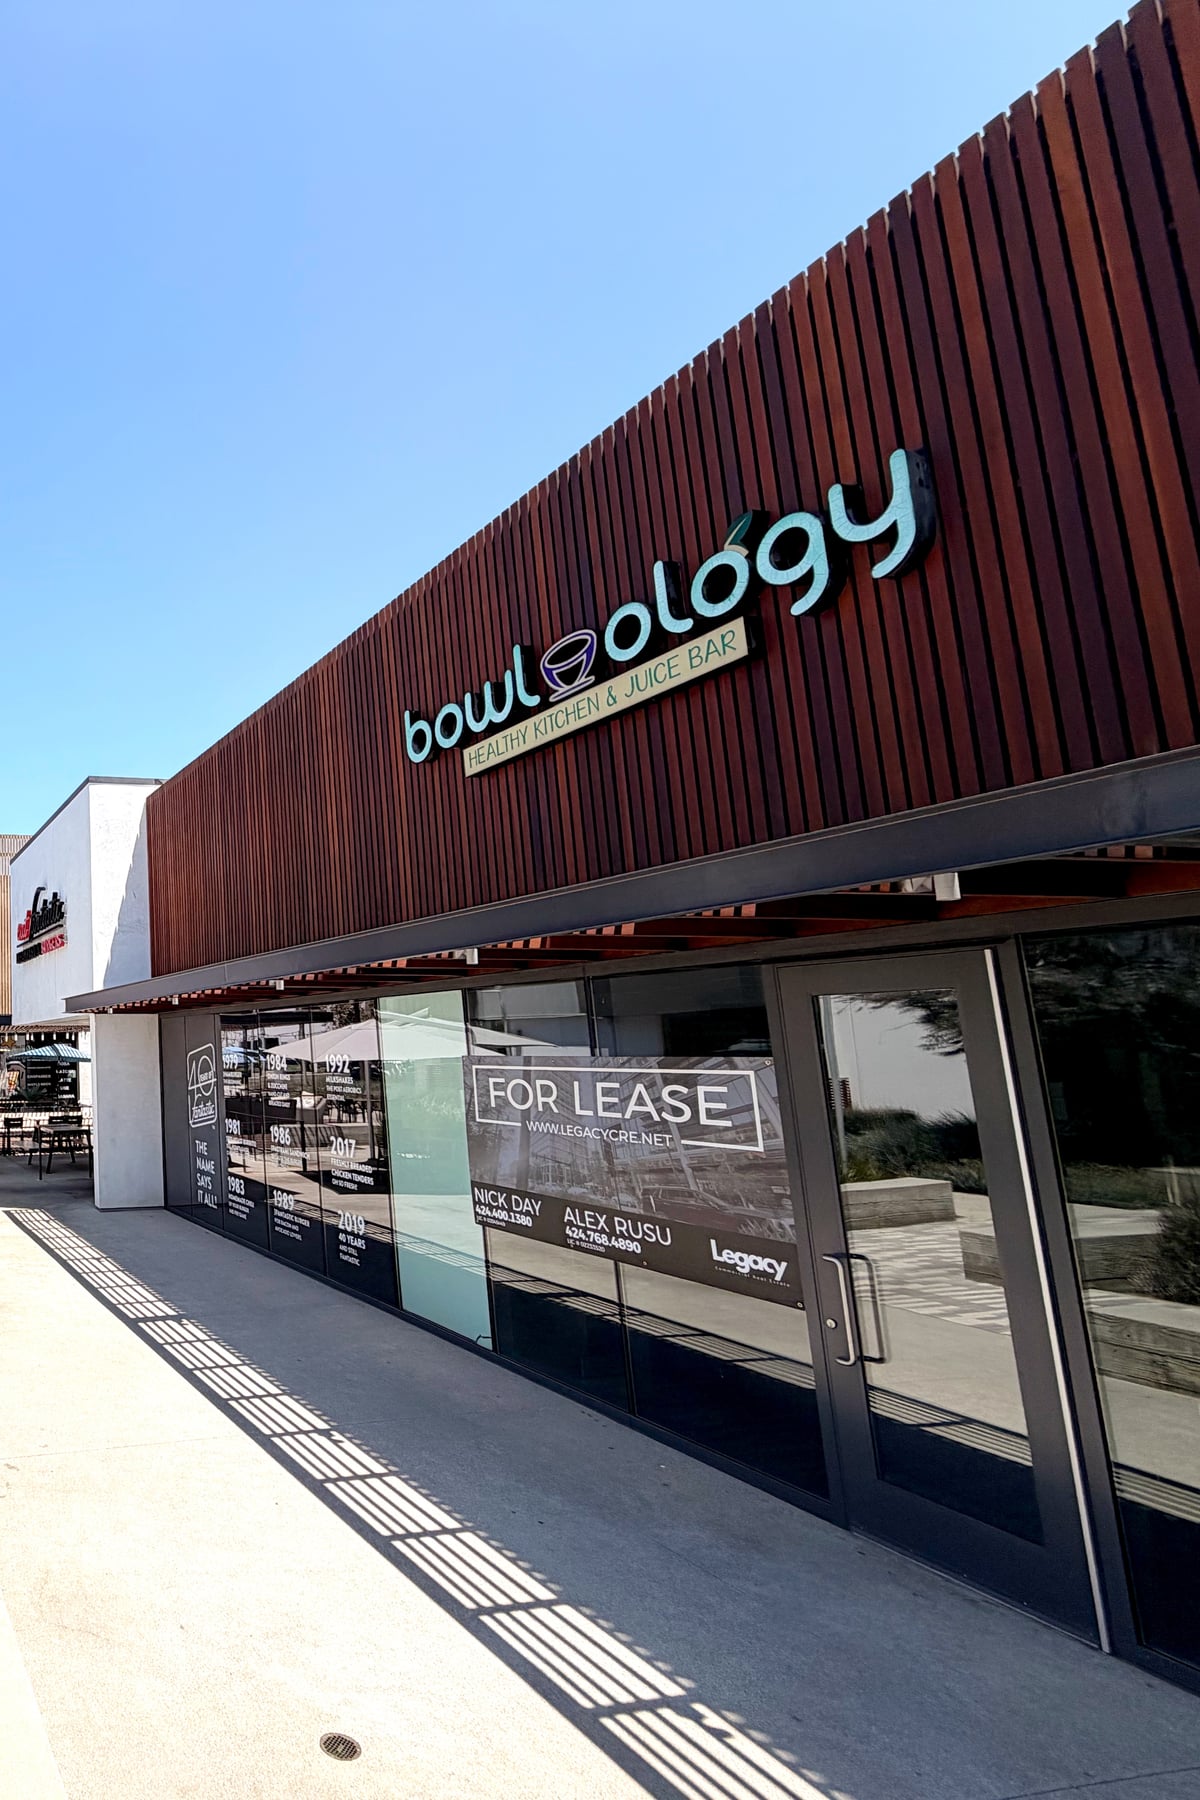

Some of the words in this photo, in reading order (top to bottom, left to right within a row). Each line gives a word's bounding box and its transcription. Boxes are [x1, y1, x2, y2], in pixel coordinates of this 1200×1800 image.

[404, 643, 540, 763] bowl
[604, 448, 916, 662] ology
[468, 725, 529, 768] HEALTHY
[534, 692, 600, 739] KITCHEN
[606, 686, 617, 707] &
[624, 654, 681, 698] JUICE
[688, 629, 737, 670] BAR
[222, 1054, 239, 1070] 1979
[266, 1054, 288, 1071] 1984
[325, 1054, 350, 1073] 1992
[488, 1077, 560, 1115] FOR
[573, 1080, 733, 1128] LEASE
[225, 1118, 240, 1136] 1981
[270, 1125, 291, 1146] 1986
[525, 1120, 673, 1148] WWW.LEGACYCRE.NET
[195, 1140, 208, 1156] THE
[330, 1135, 356, 1158] 2017
[196, 1156, 215, 1175] NAME
[196, 1172, 212, 1190] SAYS
[227, 1175, 245, 1195] 1983
[331, 1168, 352, 1180] CHICKEN
[352, 1173, 374, 1186] TENDERS
[197, 1189, 204, 1204] IT
[204, 1192, 218, 1210] ALL!
[273, 1189, 294, 1211] 1989
[474, 1187, 509, 1209] NICK
[511, 1195, 542, 1217] DAY
[337, 1209, 365, 1236] 2019
[475, 1204, 533, 1228] 424.400.1380
[564, 1206, 610, 1233] ALEX
[614, 1216, 672, 1247] RUSU
[338, 1232, 346, 1243] 40
[346, 1233, 366, 1250] YEARS
[565, 1225, 642, 1254] 424.768.4890
[710, 1238, 788, 1281] Legacy
